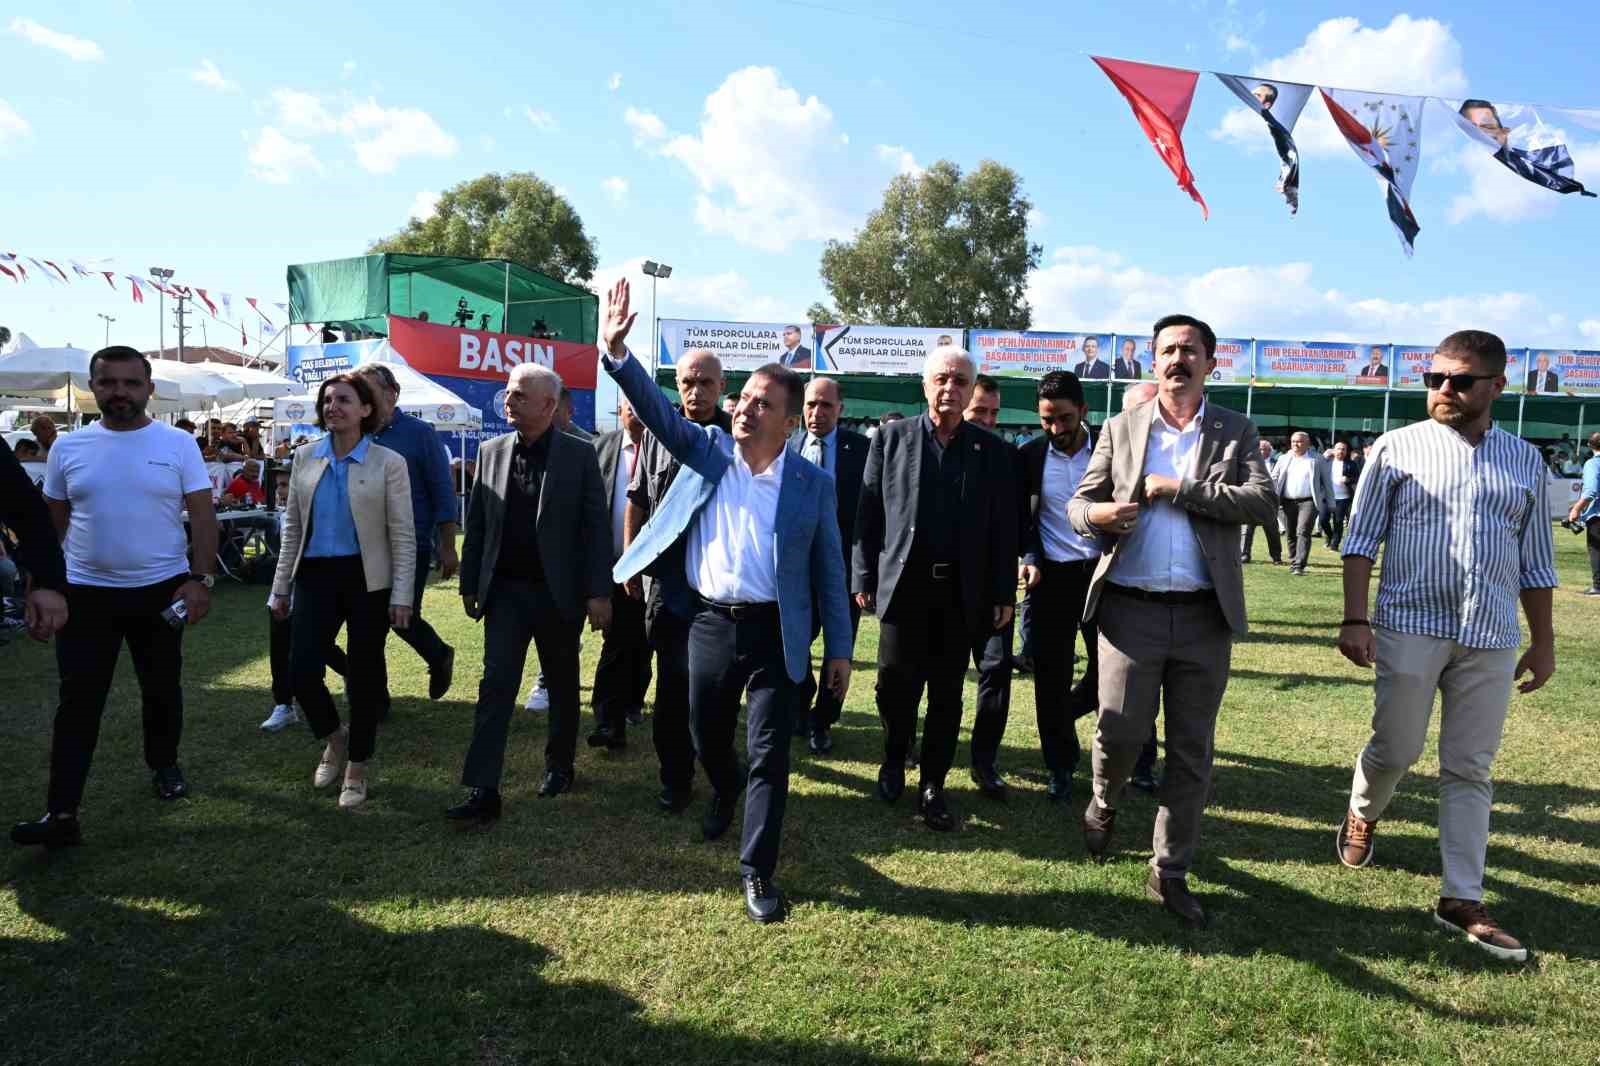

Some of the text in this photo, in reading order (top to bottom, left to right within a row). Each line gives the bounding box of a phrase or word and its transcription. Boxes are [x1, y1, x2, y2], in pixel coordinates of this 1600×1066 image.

[710, 328, 777, 339] SPORCULARA
[740, 341, 780, 351] DİLERİM
[863, 337, 924, 347] SPORCULARA
[459, 334, 553, 373] BASIN
[838, 347, 927, 358] BAŞARILAR DİLERİM
